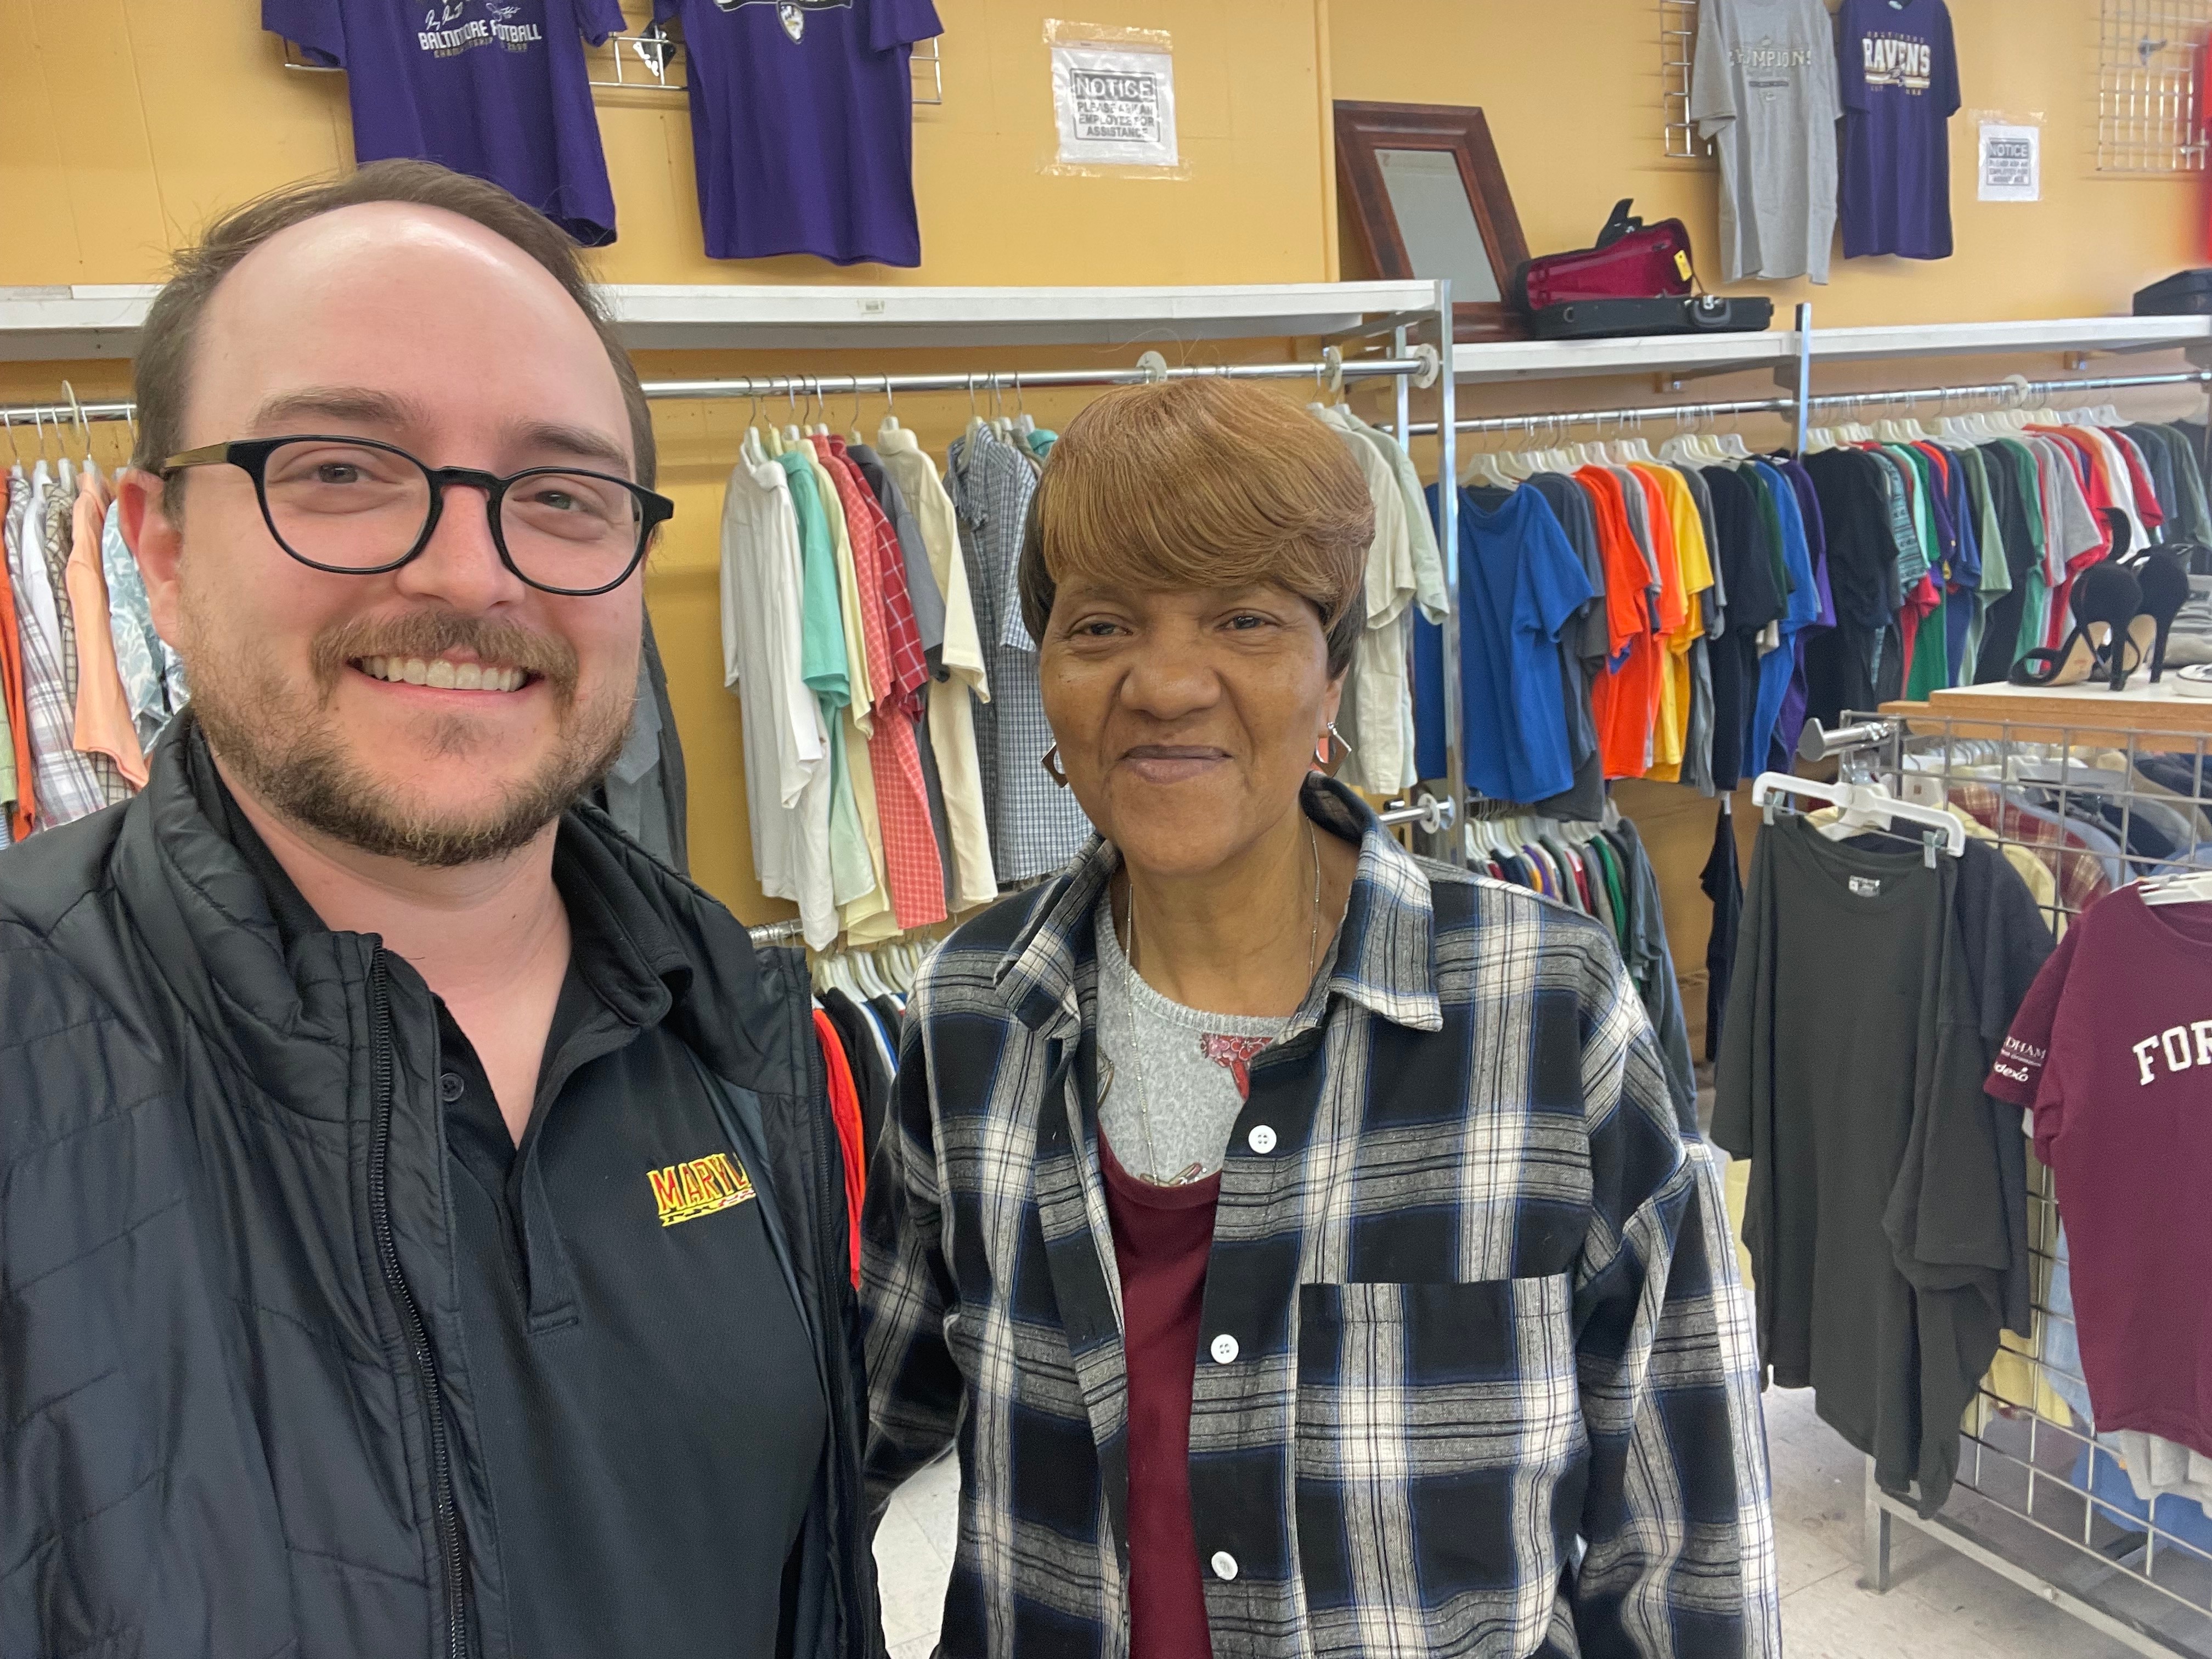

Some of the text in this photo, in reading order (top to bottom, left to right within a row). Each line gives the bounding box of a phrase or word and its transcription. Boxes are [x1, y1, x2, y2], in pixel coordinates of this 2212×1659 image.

[1862, 38, 1931, 77] RAVENS
[1076, 77, 1152, 99] NOTICE
[1077, 101, 1115, 113] PLESE
[1989, 143, 2029, 157] NOTICE
[2004, 1036, 2046, 1059] DHAM
[646, 1152, 752, 1215] MARYL
